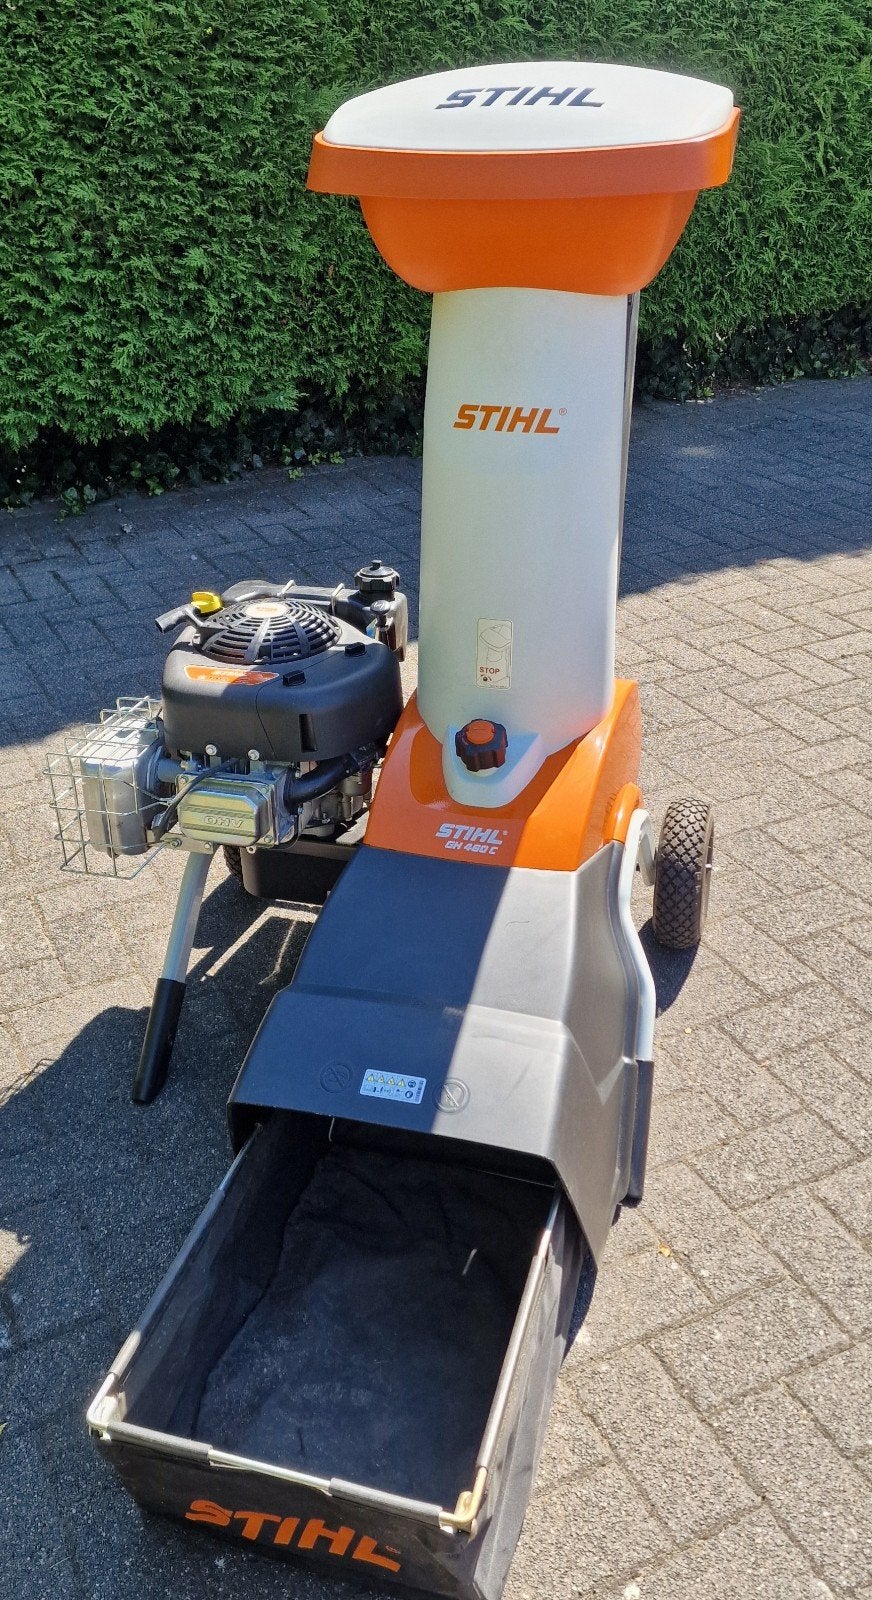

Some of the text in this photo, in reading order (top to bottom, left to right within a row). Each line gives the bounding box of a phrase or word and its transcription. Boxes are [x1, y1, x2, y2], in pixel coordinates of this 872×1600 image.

[435, 86, 605, 109] STIHL
[453, 403, 560, 434] STIHL
[479, 666, 500, 674] STOP
[203, 815, 244, 829] OHV
[436, 823, 503, 845] STIHL
[444, 840, 463, 849] GH
[489, 846, 499, 854] C
[185, 1499, 401, 1573] STIHL
